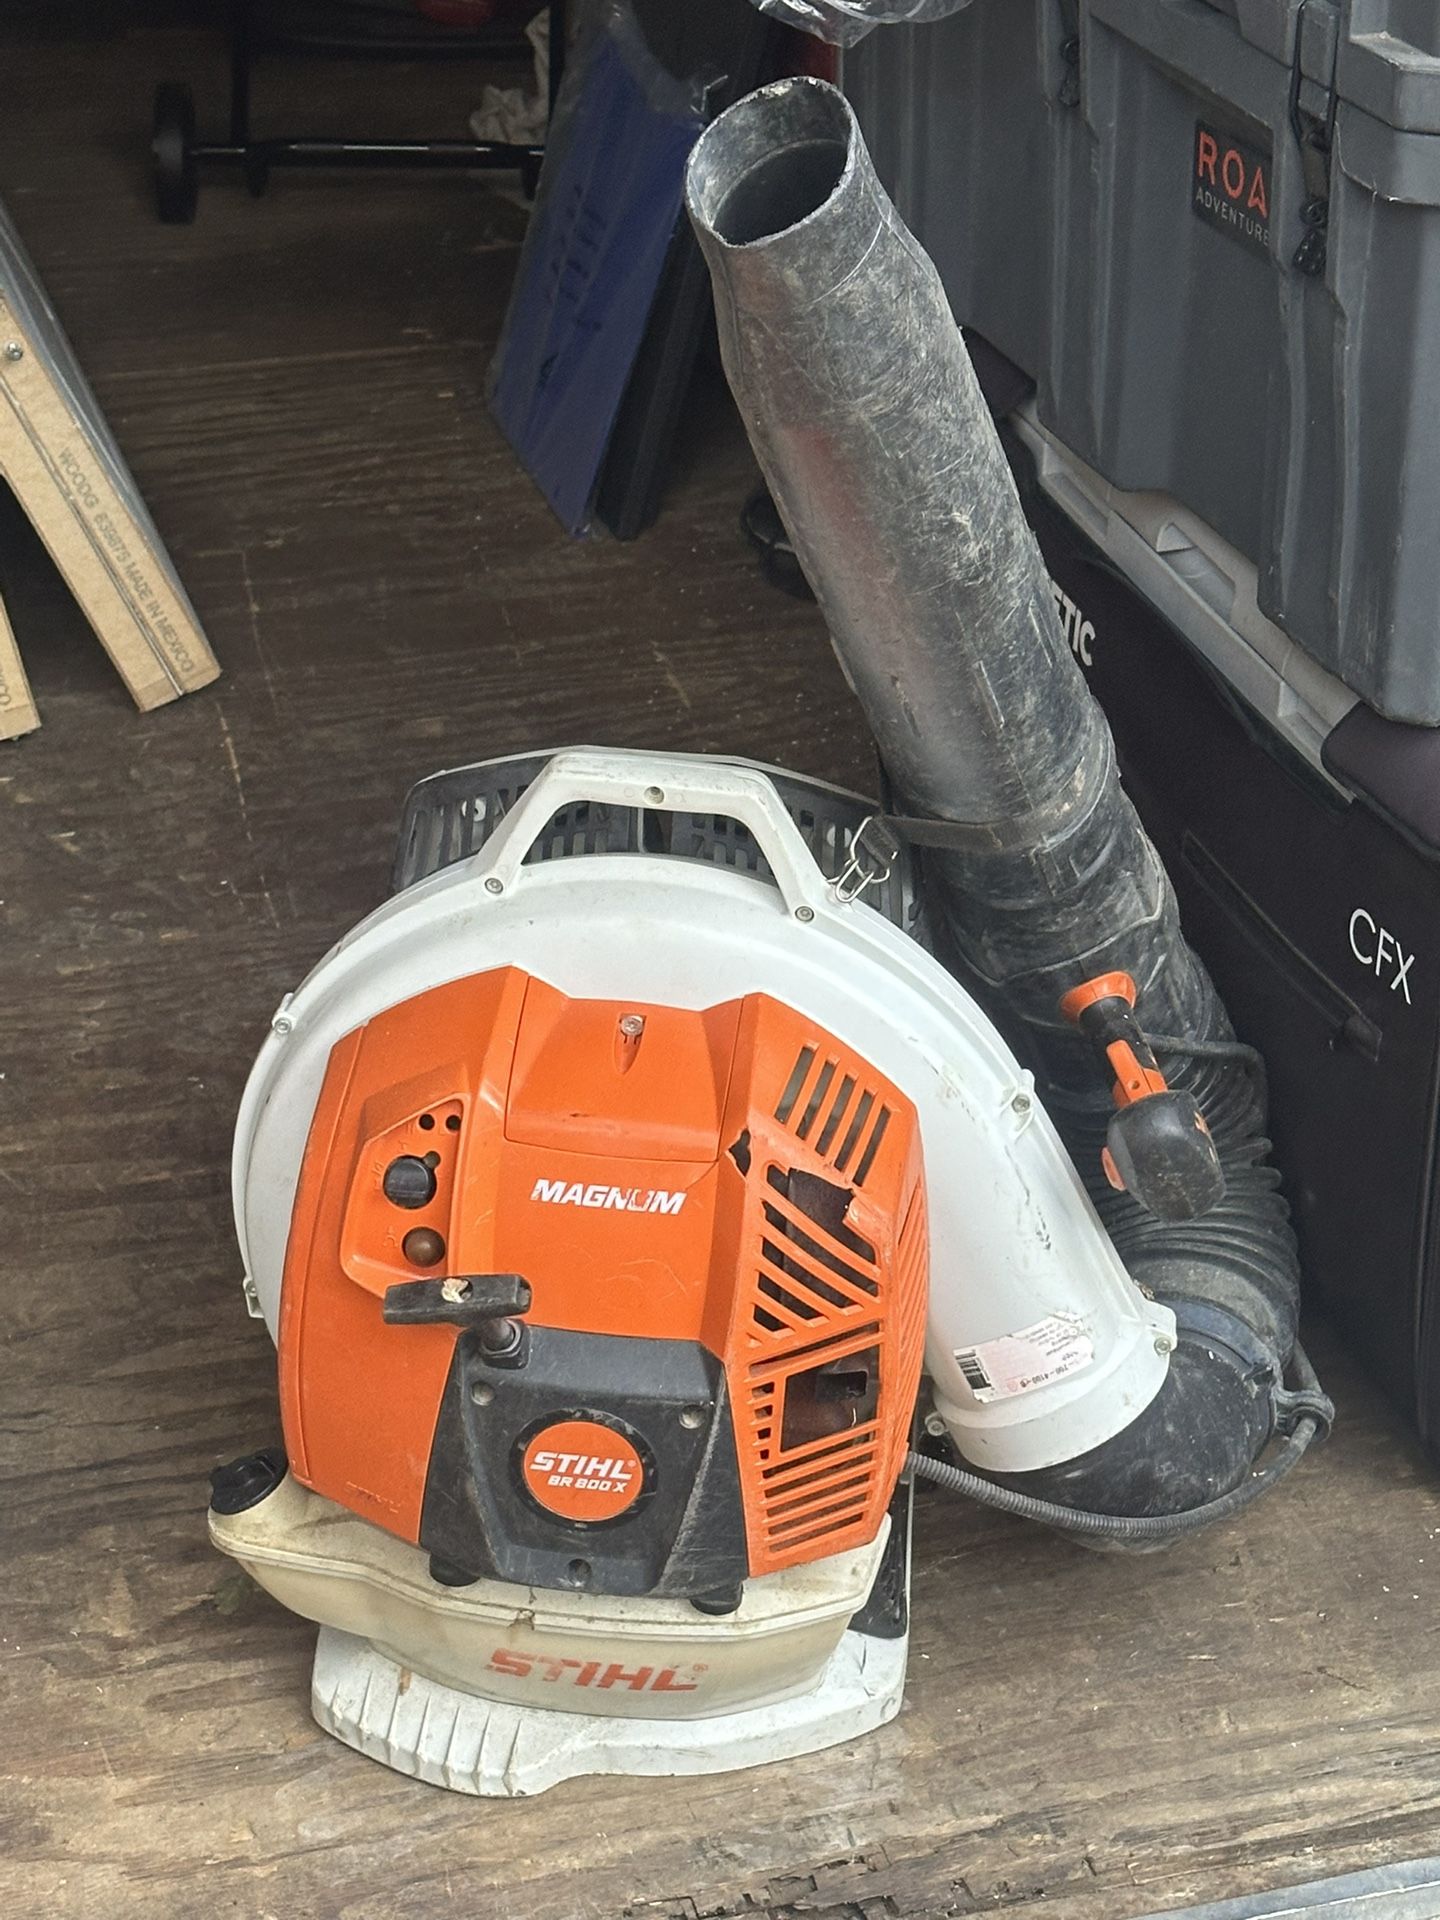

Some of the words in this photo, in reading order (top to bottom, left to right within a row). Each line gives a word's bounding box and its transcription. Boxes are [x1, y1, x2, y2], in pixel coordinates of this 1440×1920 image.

[1198, 130, 1268, 219] ROA
[1195, 186, 1270, 247] ADVENTURE
[125, 562, 153, 600] MADE
[146, 599, 165, 620] IN
[154, 616, 195, 673] MEXICO
[1349, 908, 1415, 1005] CFX
[530, 1178, 688, 1215] MAGNUM
[530, 1451, 633, 1480] STIHL
[547, 1475, 574, 1488] BR
[575, 1478, 612, 1492] 800
[612, 1481, 628, 1493] X
[484, 1648, 698, 1691] STIHL
